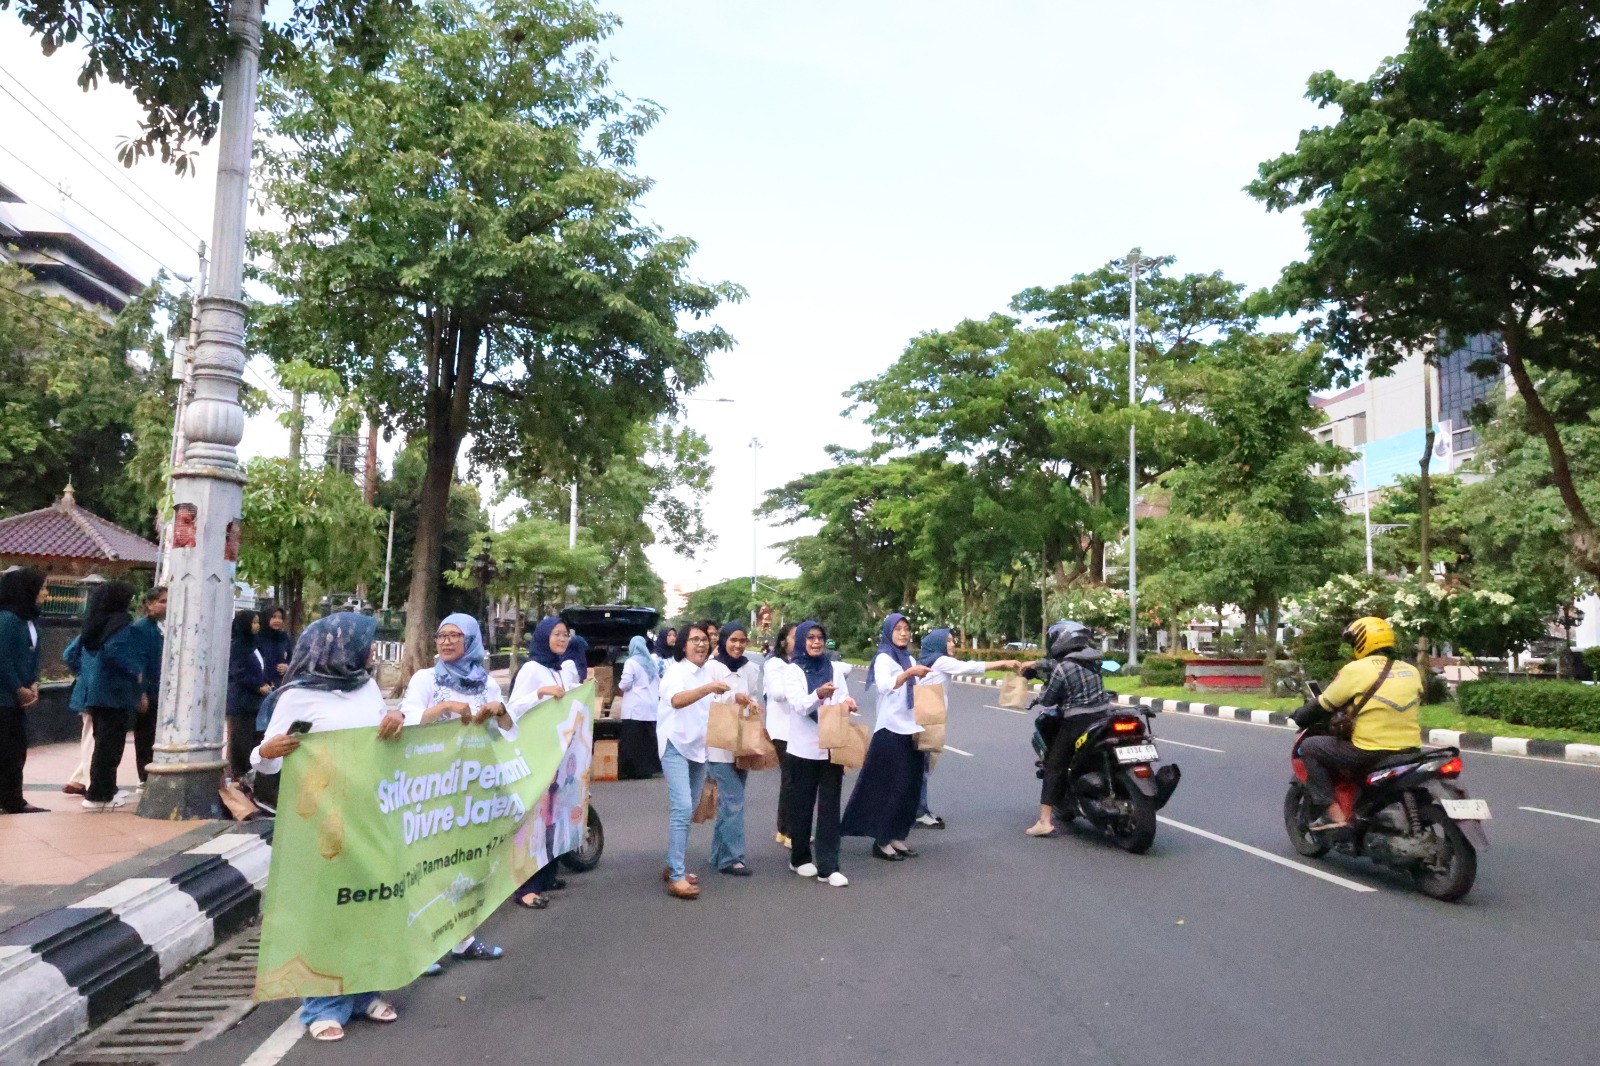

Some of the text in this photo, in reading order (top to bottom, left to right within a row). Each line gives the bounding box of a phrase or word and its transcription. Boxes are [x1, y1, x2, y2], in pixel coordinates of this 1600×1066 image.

[378, 759, 461, 814] Srikandi
[403, 792, 526, 845] Divre Jateng
[337, 873, 405, 905] Berbagi
[422, 847, 482, 877] Ramadhan
